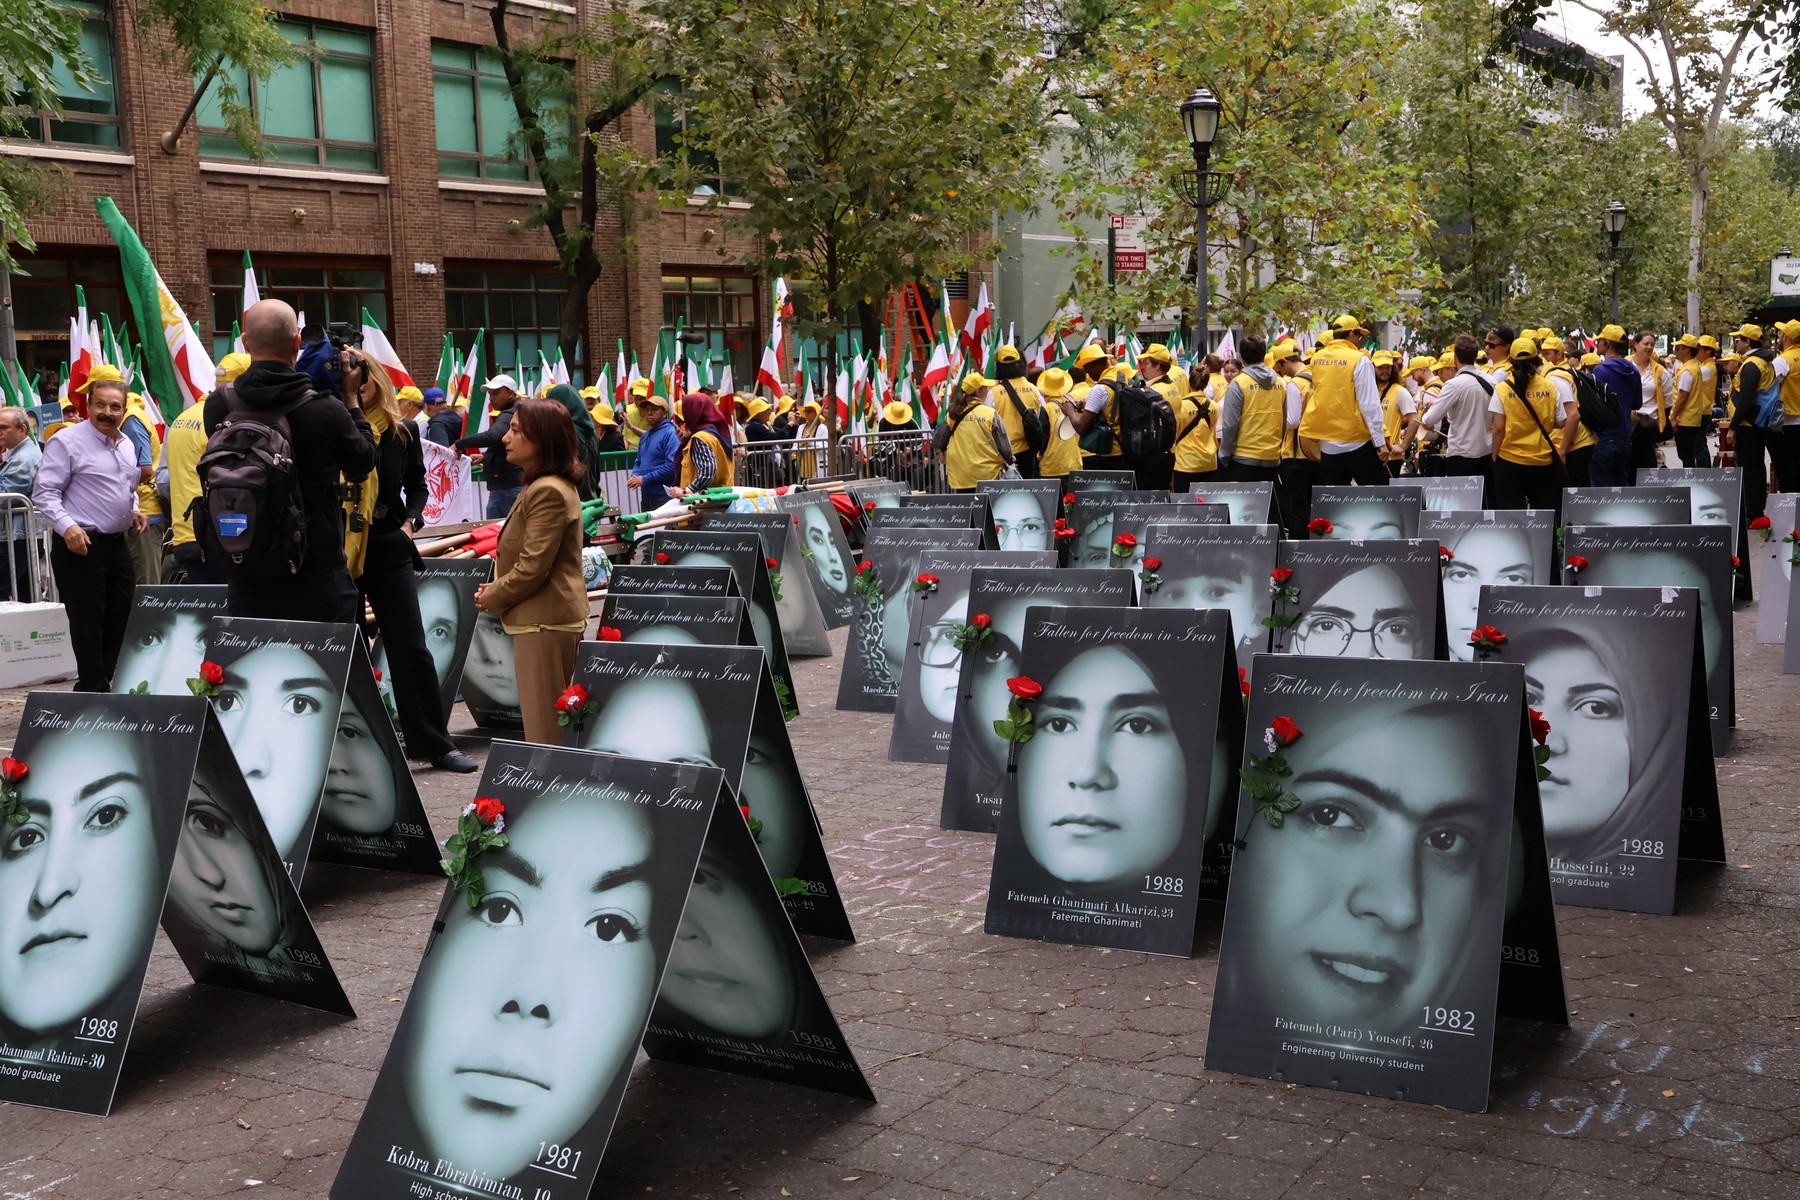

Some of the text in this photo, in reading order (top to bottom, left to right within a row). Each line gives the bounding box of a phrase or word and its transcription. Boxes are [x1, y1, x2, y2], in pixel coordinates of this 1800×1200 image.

[1317, 494, 1340, 502] Fallen
[1342, 496, 1353, 504] for
[1353, 495, 1382, 503] freedom
[1395, 493, 1416, 502] Iran
[1569, 495, 1597, 504] Fallen
[1598, 497, 1611, 505] for
[1612, 496, 1645, 504] freedom
[1660, 494, 1685, 504] Iran
[1426, 520, 1455, 529] Fallen
[1456, 521, 1471, 530] for
[1471, 520, 1506, 529] freedom
[1522, 519, 1547, 529] Iran
[659, 540, 681, 550] Fallen
[681, 542, 694, 552] for
[694, 543, 721, 552] freedom
[733, 541, 753, 552] Iran
[870, 536, 896, 545] Fallen
[896, 539, 908, 547] for
[908, 539, 939, 547] freedom
[952, 539, 974, 547] Iran
[1152, 533, 1181, 545] Fallen
[1181, 536, 1197, 546] for
[1196, 536, 1230, 546] freedom
[1246, 535, 1271, 545] Iran
[1573, 535, 1723, 550] Fallen for freedom in Iran
[1287, 551, 1431, 565] Fallen for freedom in Iran
[615, 576, 722, 591] Fallen for freedom in Iran
[978, 579, 1123, 596] Fallen for freedom in Iran
[138, 596, 162, 607] Fallen
[160, 599, 176, 610] for
[173, 599, 206, 610] freedom
[1489, 599, 1686, 619] Fallen for freedom in Iran
[608, 607, 734, 624] Fallen for freedom in Iran
[1034, 620, 1216, 644] Fallen for freedom in Iran
[214, 632, 346, 652] Fallen for freedom in Iran
[584, 656, 750, 681] Fallen for freedom in Iran
[1263, 673, 1508, 703] Fallen for freedom in Iran
[30, 708, 195, 735] Fallen for freedom in Iran
[492, 763, 704, 811] Fallen for freedom in Iran
[395, 822, 424, 836] 1988
[1622, 838, 1664, 857] 1988
[1550, 857, 1635, 876] Hosseini, 22
[1145, 875, 1184, 895] 1988
[1568, 878, 1609, 888] graduate
[1007, 891, 1049, 905] Fatemeh
[1052, 896, 1108, 911] Ghanimati
[1052, 911, 1141, 931] Fatemeh Ghanimati
[287, 947, 321, 966] 1988
[1501, 945, 1540, 963] 988
[1423, 1005, 1475, 1031] 1982
[80, 1016, 119, 1040] 1988
[1274, 1017, 1434, 1050] Fatemeh (Pari) Yousefi, 26
[789, 1030, 836, 1051] 1988
[47, 1049, 106, 1070] Rahimi-30
[707, 1047, 794, 1071] Manager, Engineer
[1282, 1041, 1425, 1072] Engineering University student
[22, 1069, 62, 1083] graduate
[535, 1140, 582, 1173] 1981
[386, 1144, 430, 1174] Kobra
[432, 1158, 524, 1200] Ebrahimian,
[410, 1181, 433, 1199] High
